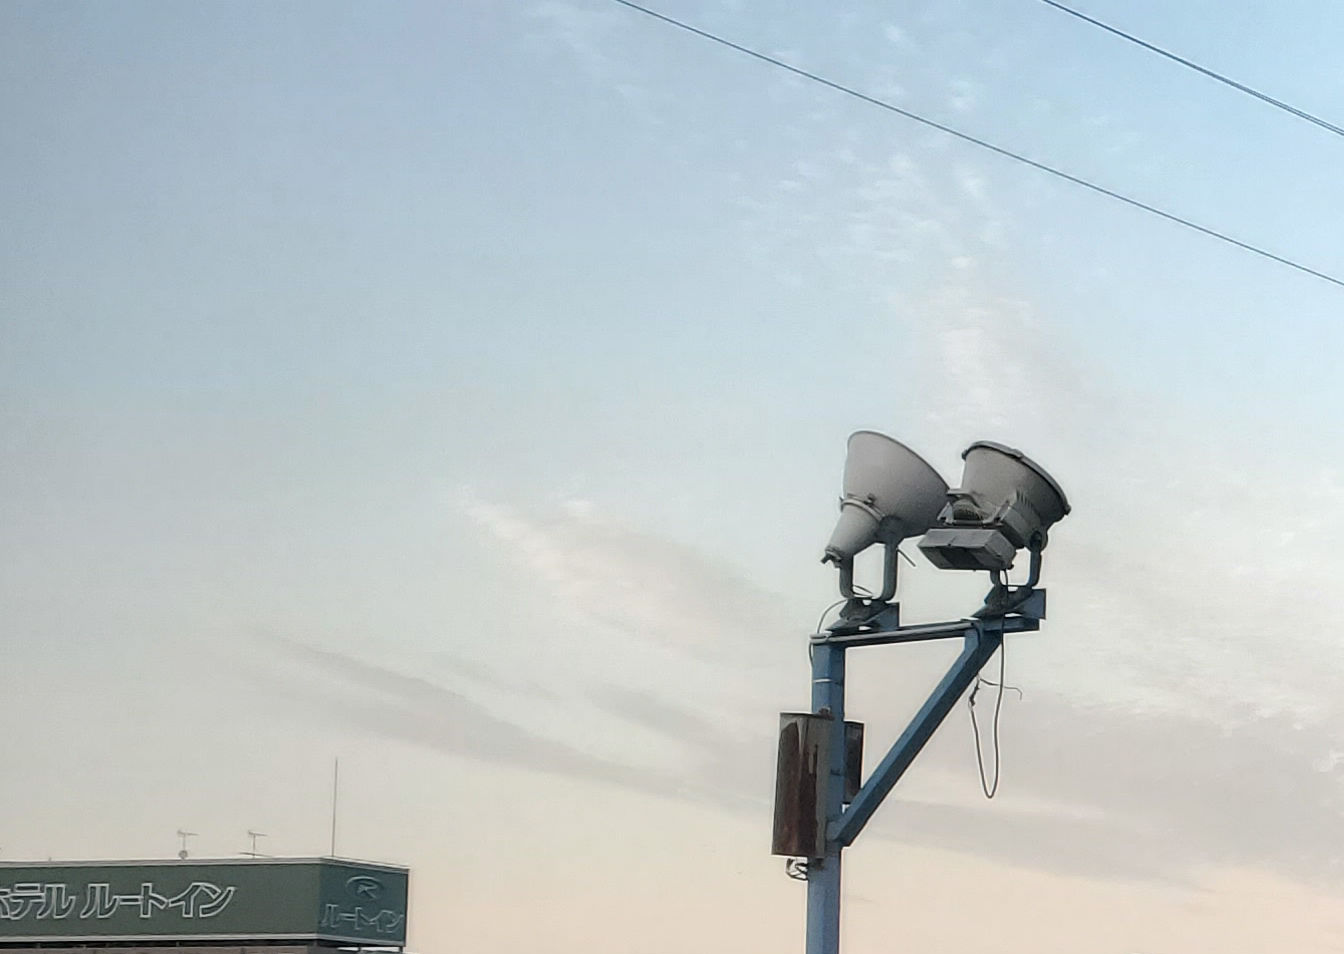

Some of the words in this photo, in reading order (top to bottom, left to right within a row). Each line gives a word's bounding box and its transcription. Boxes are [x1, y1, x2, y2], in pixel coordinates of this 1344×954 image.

[80, 882, 237, 919] ルートイン
[320, 903, 405, 933] ルートイン
